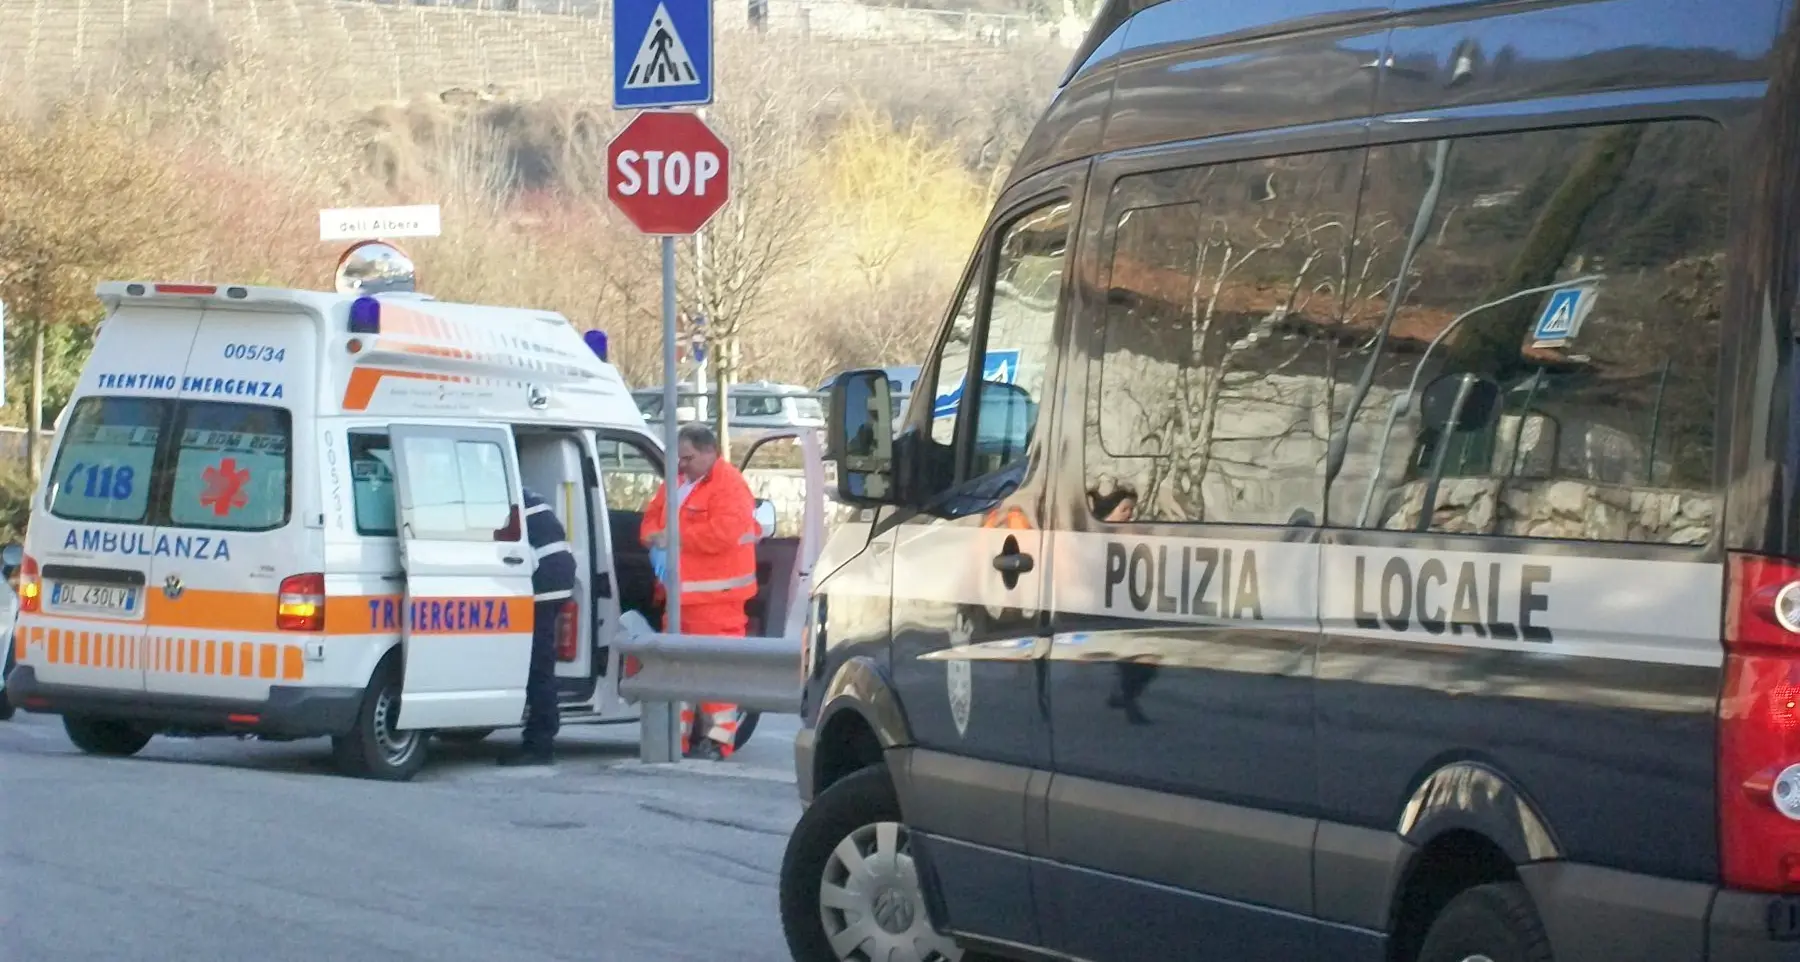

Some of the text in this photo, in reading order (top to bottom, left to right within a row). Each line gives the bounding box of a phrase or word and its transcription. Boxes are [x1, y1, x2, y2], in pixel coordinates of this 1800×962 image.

[616, 149, 720, 196] STOP
[224, 343, 286, 363] 005/34
[98, 374, 284, 399] TRENTINO EMERGENZA
[84, 464, 134, 500] 118
[64, 528, 231, 561] AMBULANZA
[1104, 542, 1553, 643] POLIZIA LOCALE
